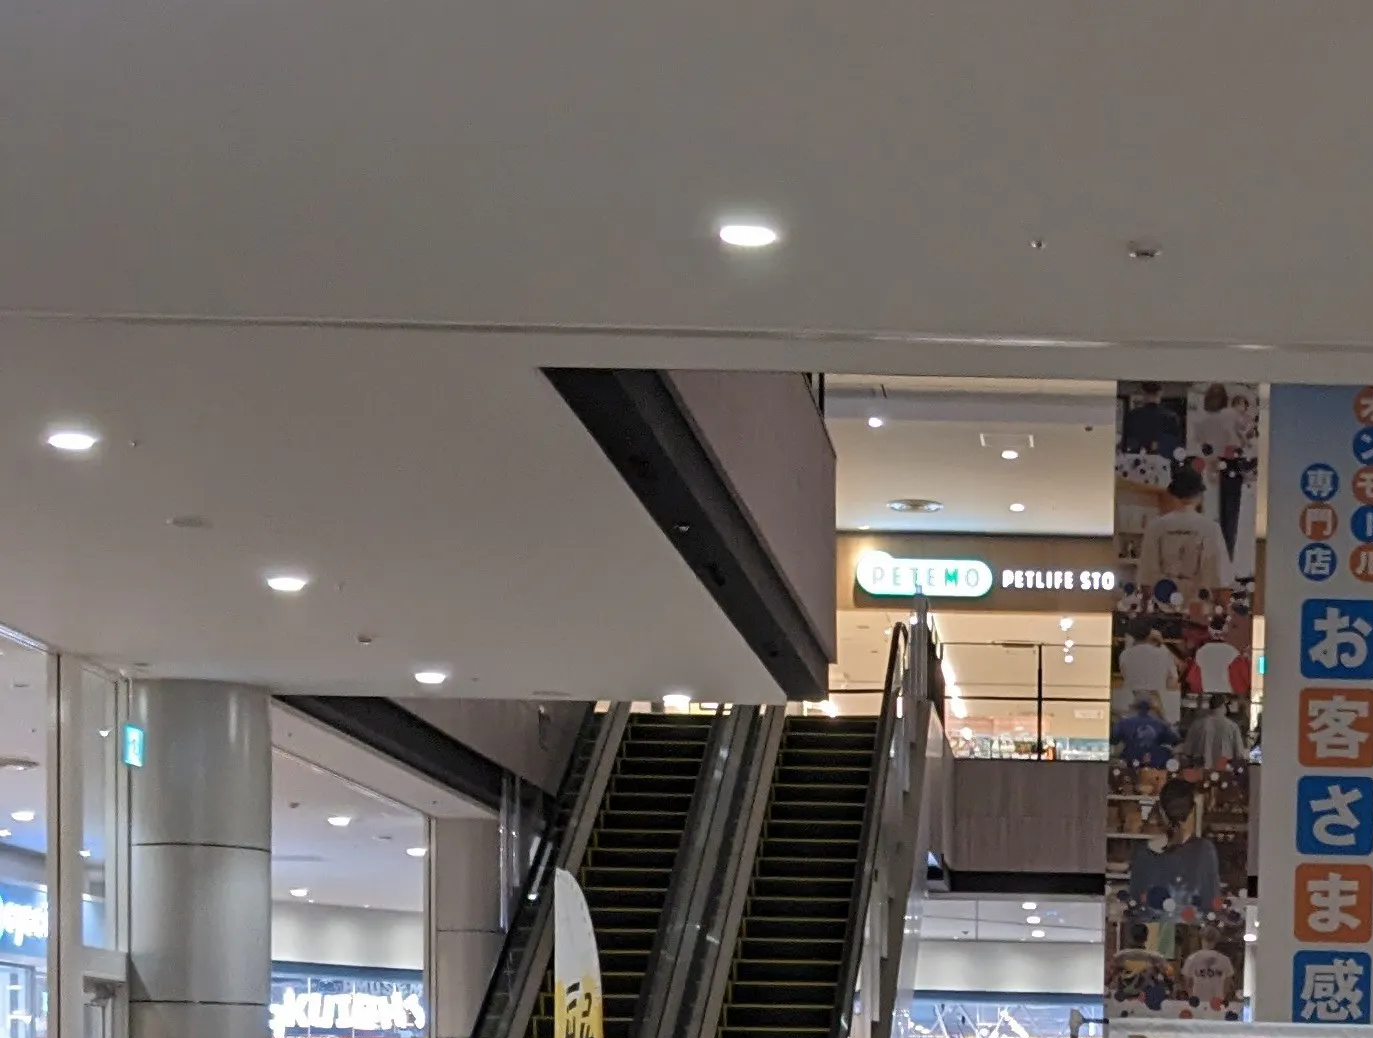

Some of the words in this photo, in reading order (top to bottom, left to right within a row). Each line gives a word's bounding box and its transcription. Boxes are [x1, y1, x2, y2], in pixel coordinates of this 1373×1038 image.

[1303, 469, 1335, 576] 専門店
[871, 566, 981, 588] PETEMO
[1002, 569, 1074, 590] PETLIFE
[1300, 606, 1373, 1022] お客さま感
